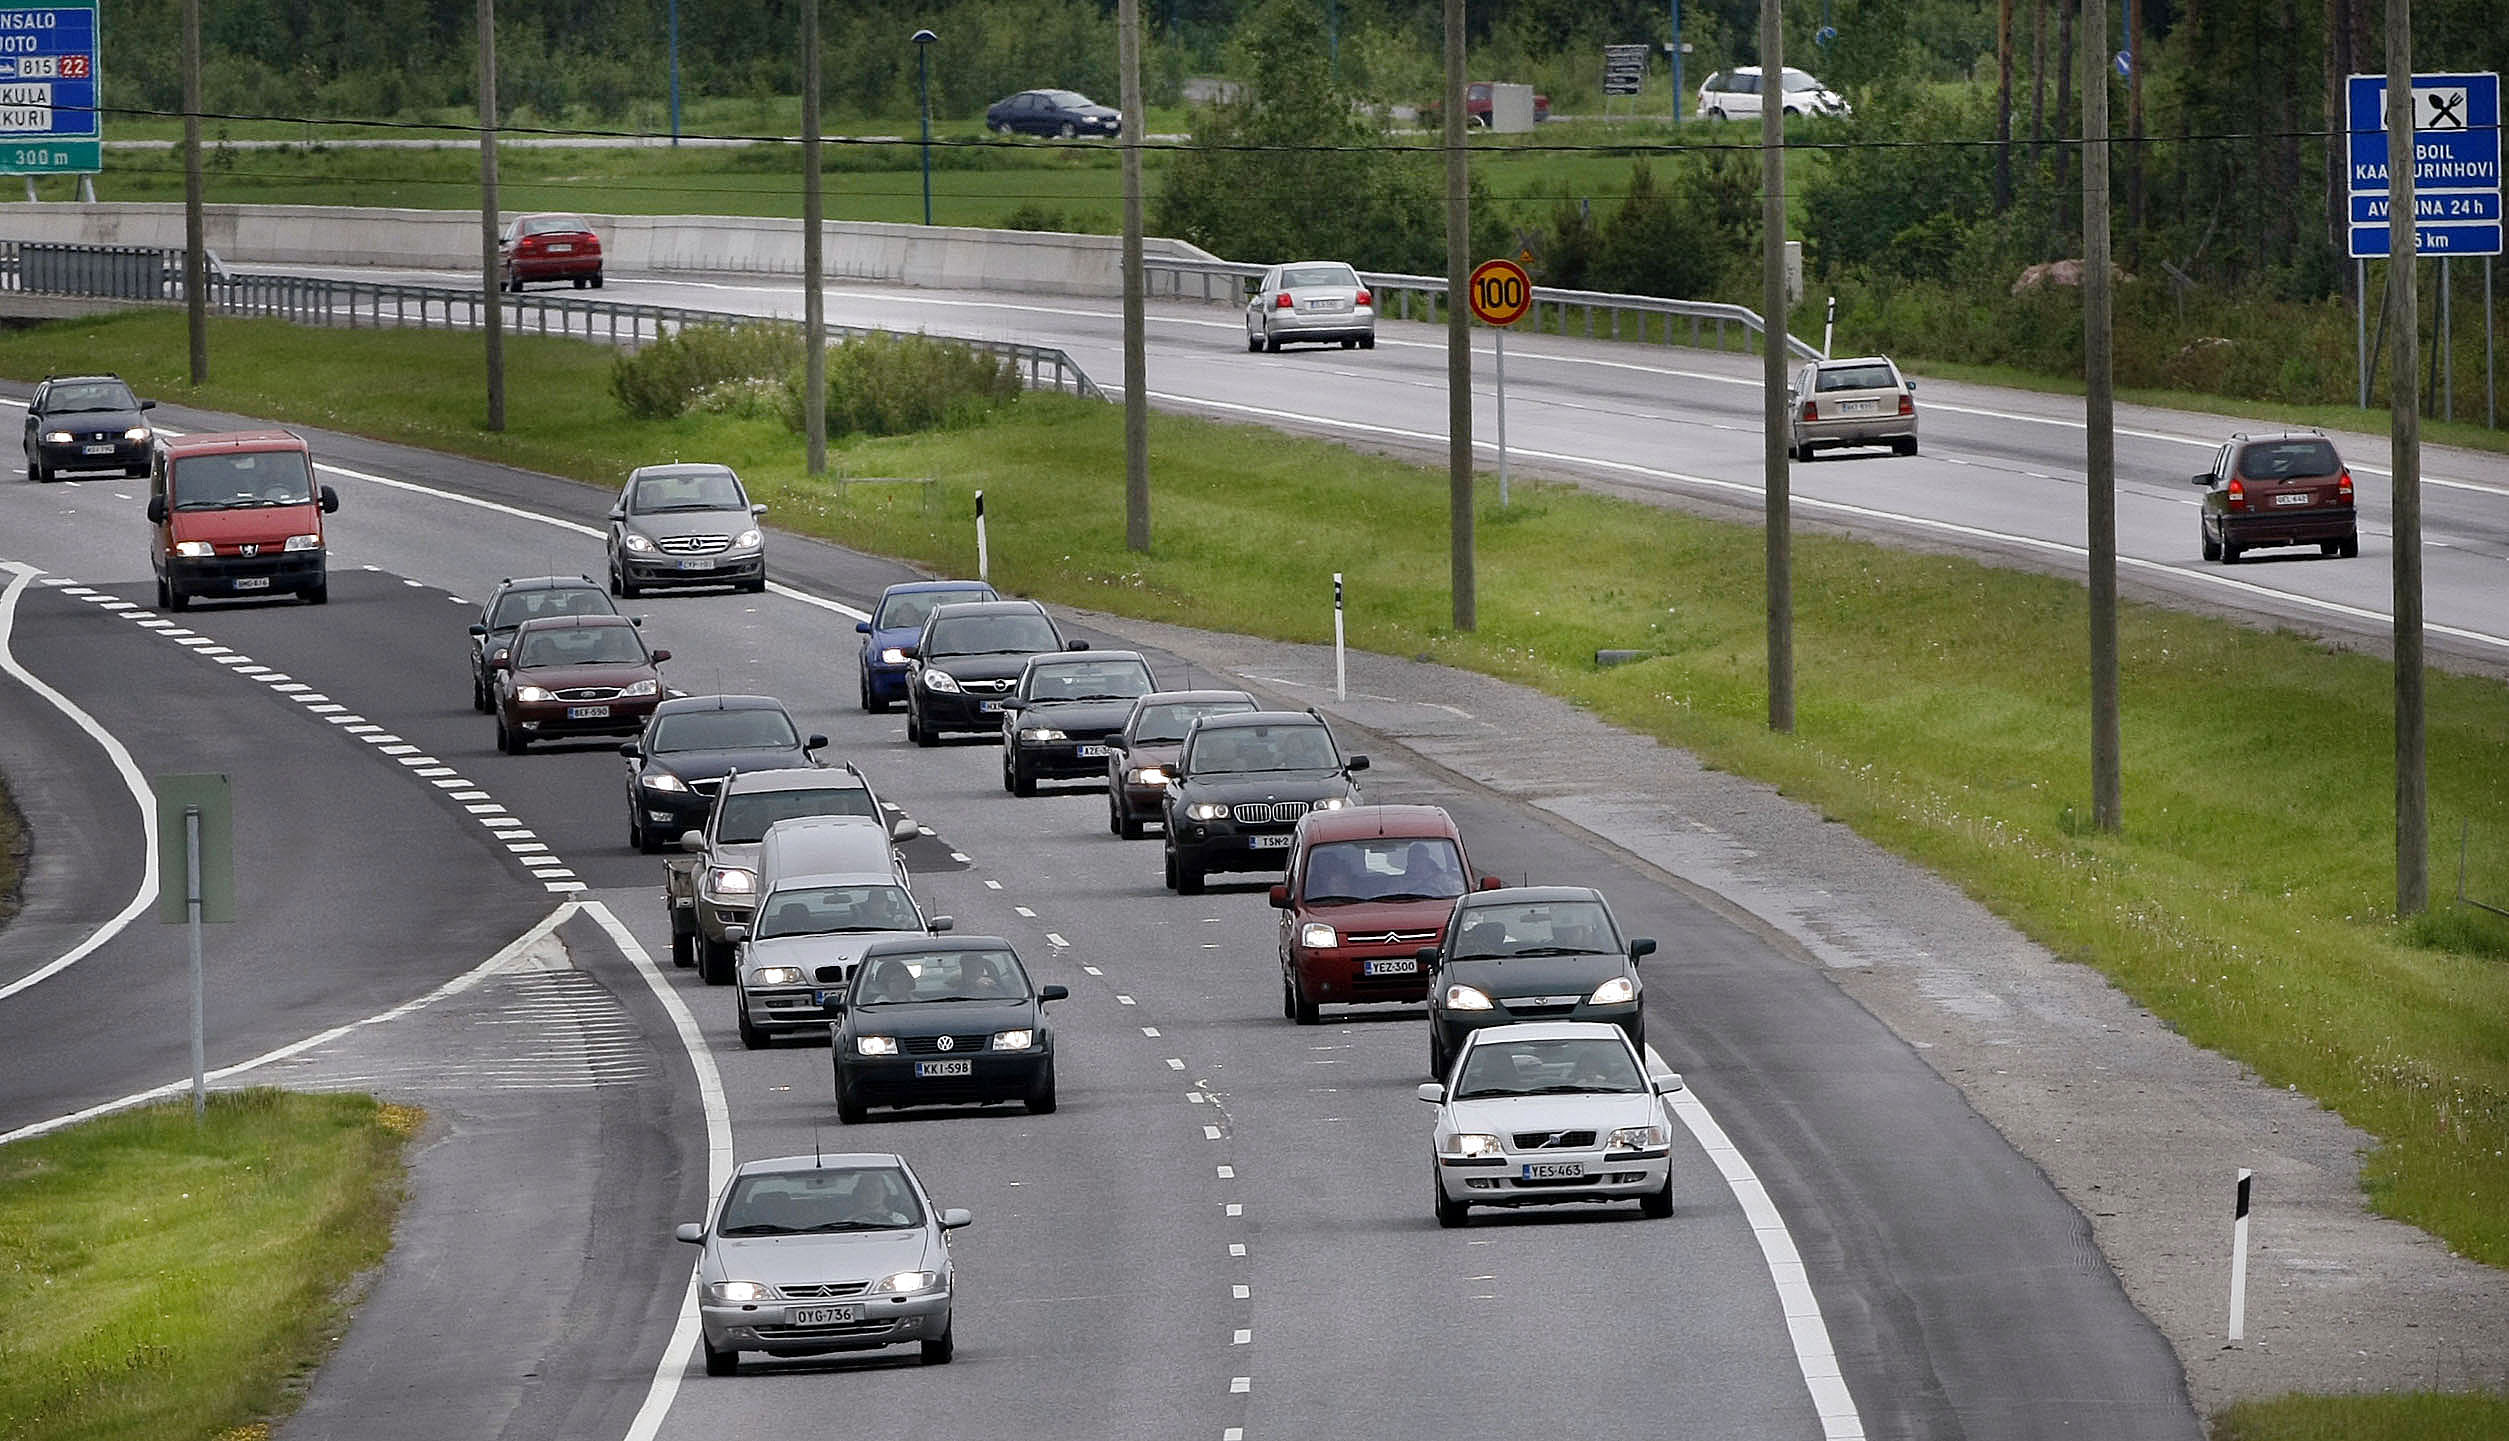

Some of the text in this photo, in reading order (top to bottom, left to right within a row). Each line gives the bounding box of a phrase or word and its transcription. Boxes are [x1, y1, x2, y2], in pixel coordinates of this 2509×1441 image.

[0, 36, 37, 52] OTO
[24, 60, 85, 75] 815 22
[16, 150, 68, 165] 300 m
[2451, 200, 2470, 215] 24
[2474, 199, 2484, 214] h
[2427, 233, 2449, 248] km
[1477, 277, 1522, 309] 100
[1372, 961, 1415, 973] YEZ-300
[923, 1062, 969, 1075] KKI-598
[1531, 1164, 1581, 1178] YES-463
[798, 1308, 852, 1323] OYG-736
